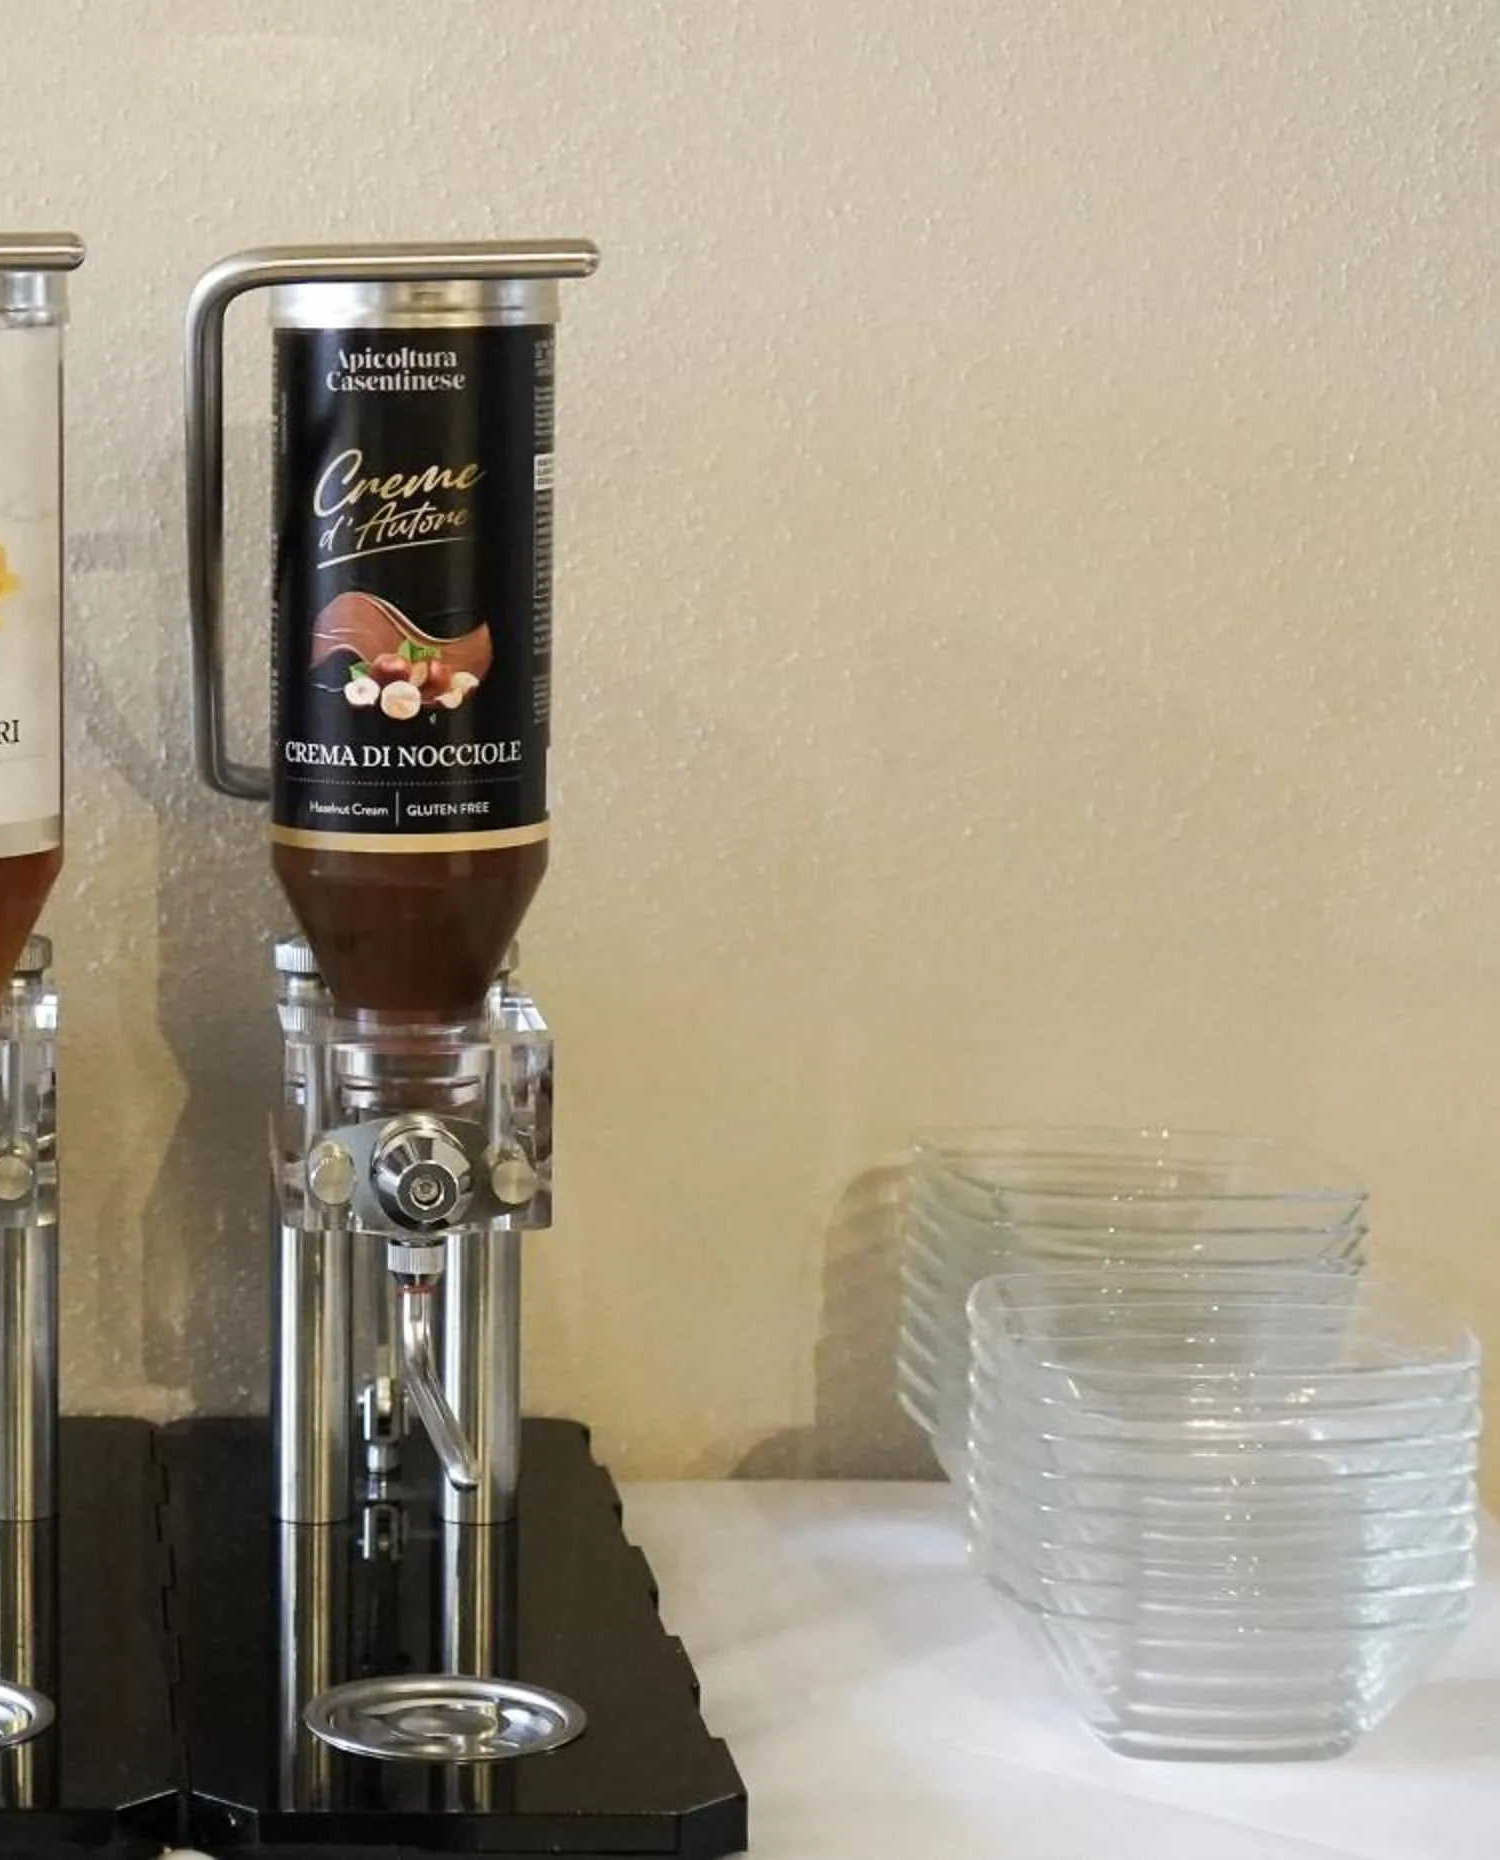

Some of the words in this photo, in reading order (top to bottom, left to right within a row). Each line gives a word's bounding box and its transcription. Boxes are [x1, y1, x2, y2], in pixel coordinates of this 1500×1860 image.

[336, 347, 457, 371] Apicoltura
[325, 369, 466, 391] Casentinese
[313, 448, 487, 517] Creme
[285, 741, 357, 767] CREMA
[362, 745, 391, 767] DI
[397, 740, 521, 767] NOCCIOLE
[309, 801, 350, 815] Hazelnut
[351, 802, 389, 816] Cream
[406, 803, 456, 817] GLUTEN
[459, 801, 491, 815] FREE
